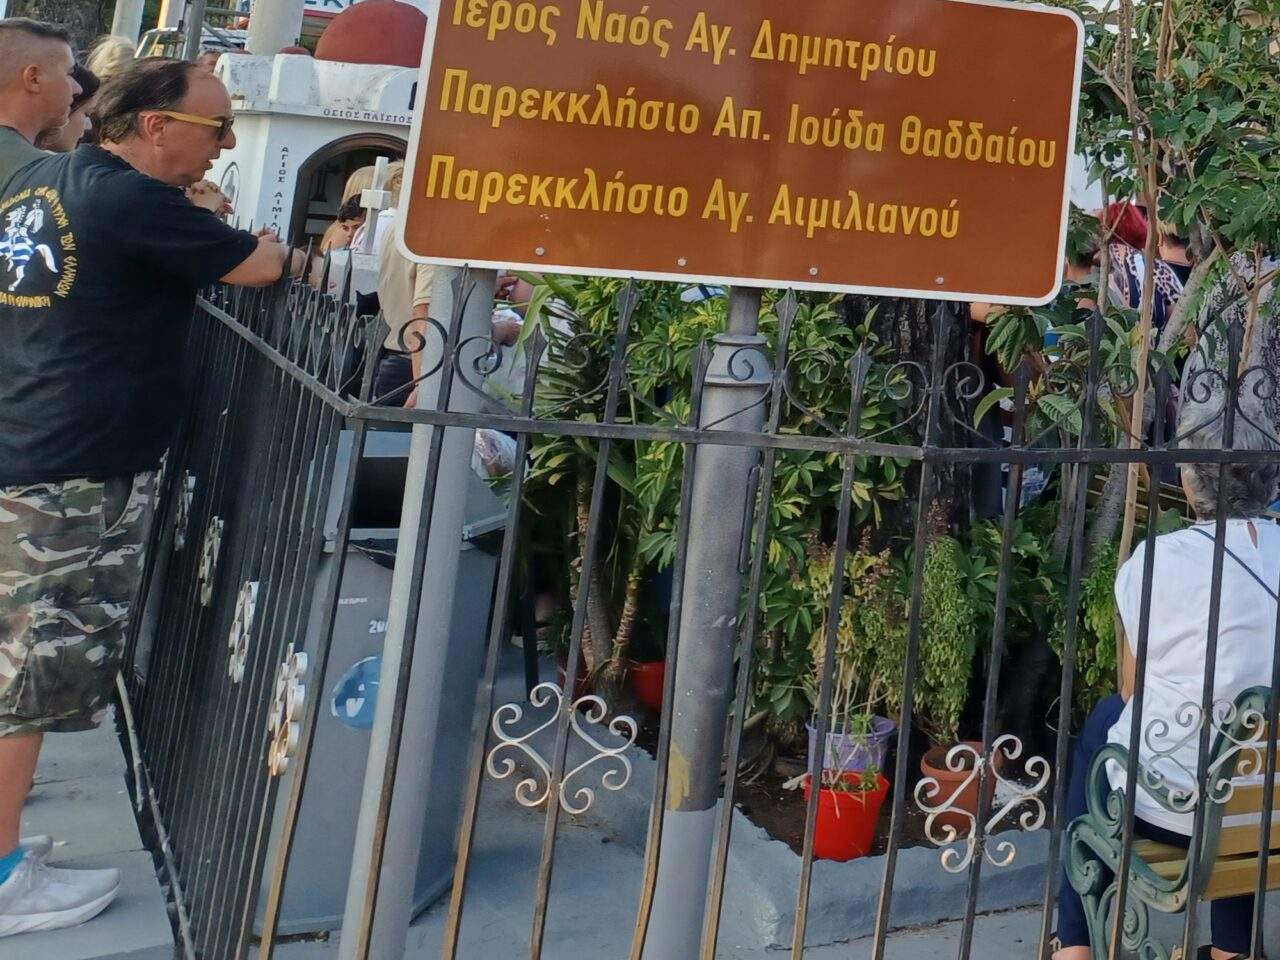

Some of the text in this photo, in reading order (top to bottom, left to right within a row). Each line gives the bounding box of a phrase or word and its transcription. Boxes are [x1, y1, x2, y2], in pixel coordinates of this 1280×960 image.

[686, 12, 736, 64] Αγ.
[751, 20, 937, 78] Δημητρίου
[323, 108, 360, 119] ΟΣΙΟΣ
[440, 68, 1057, 169] Παρεκκλήσιο Απ. Ιούδα Θαδδαίου
[278, 146, 289, 183] ΑΓΙΟΣ
[426, 154, 961, 239] Παρεκκλήσιο Αγ. Αιμιλιανού
